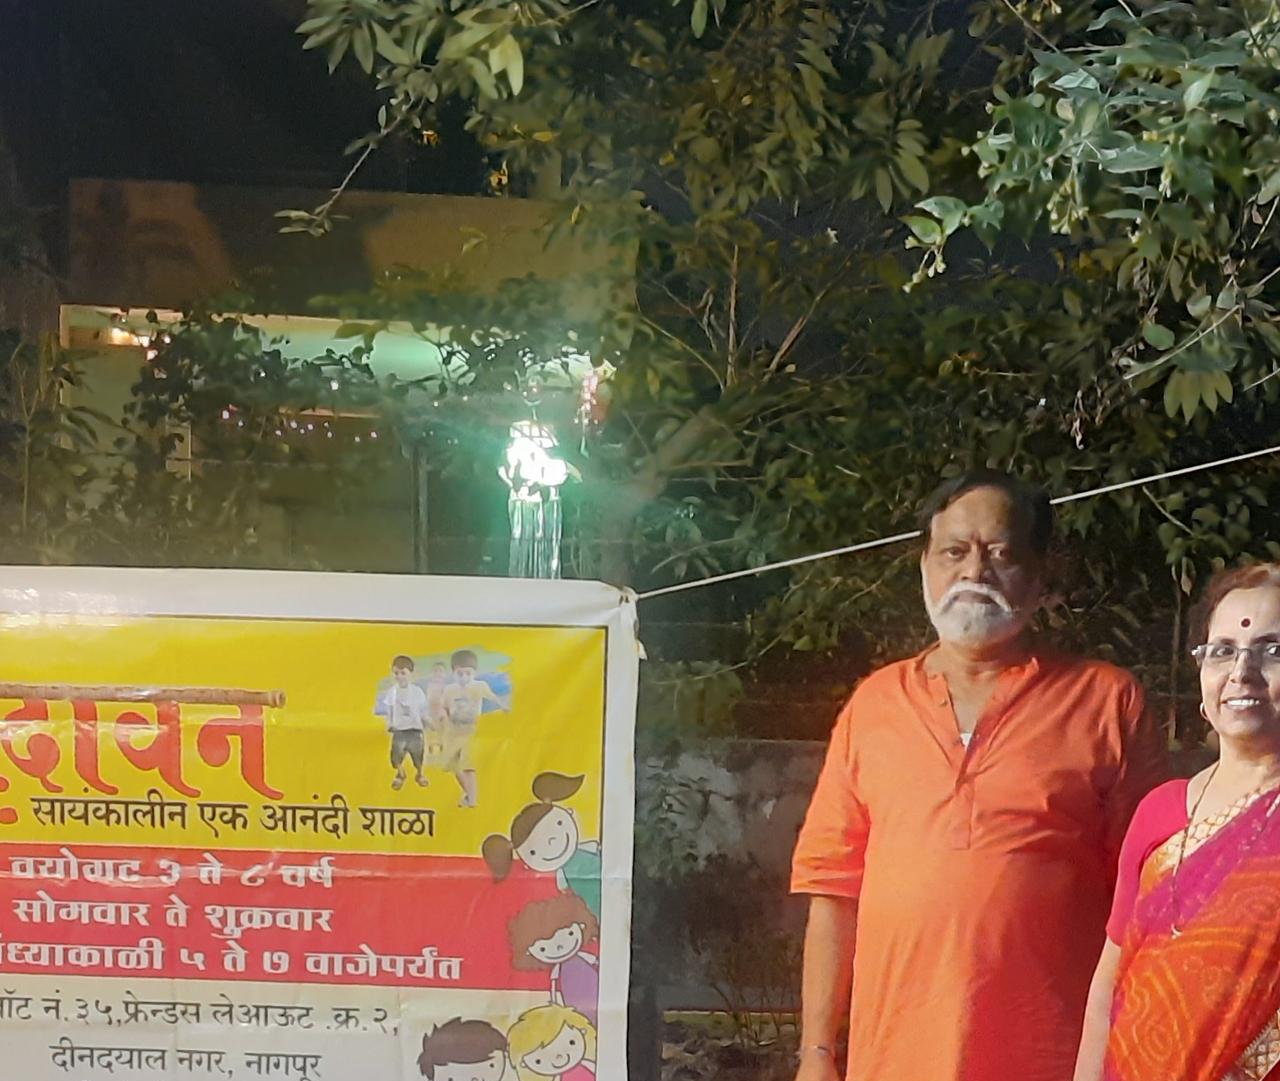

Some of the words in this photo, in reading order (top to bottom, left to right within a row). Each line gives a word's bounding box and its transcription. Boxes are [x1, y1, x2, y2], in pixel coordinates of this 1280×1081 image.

[30, 787, 189, 829] सायंकालीन
[197, 803, 248, 838] एक
[260, 794, 350, 839] आनंदी
[360, 805, 436, 838] शाळा
[8, 847, 141, 882] वयोगट
[197, 852, 224, 885] ते
[280, 856, 336, 888] वर्ष
[11, 890, 151, 926] सोमवार
[164, 894, 190, 927] ते
[204, 904, 334, 939] शुक्रवार
[179, 948, 206, 971] ५
[221, 940, 248, 973] ते
[263, 951, 290, 974] ७
[210, 993, 314, 1029] लेआऊट
[48, 1036, 168, 1073] दीनदयाल
[176, 1048, 234, 1079] नगर,
